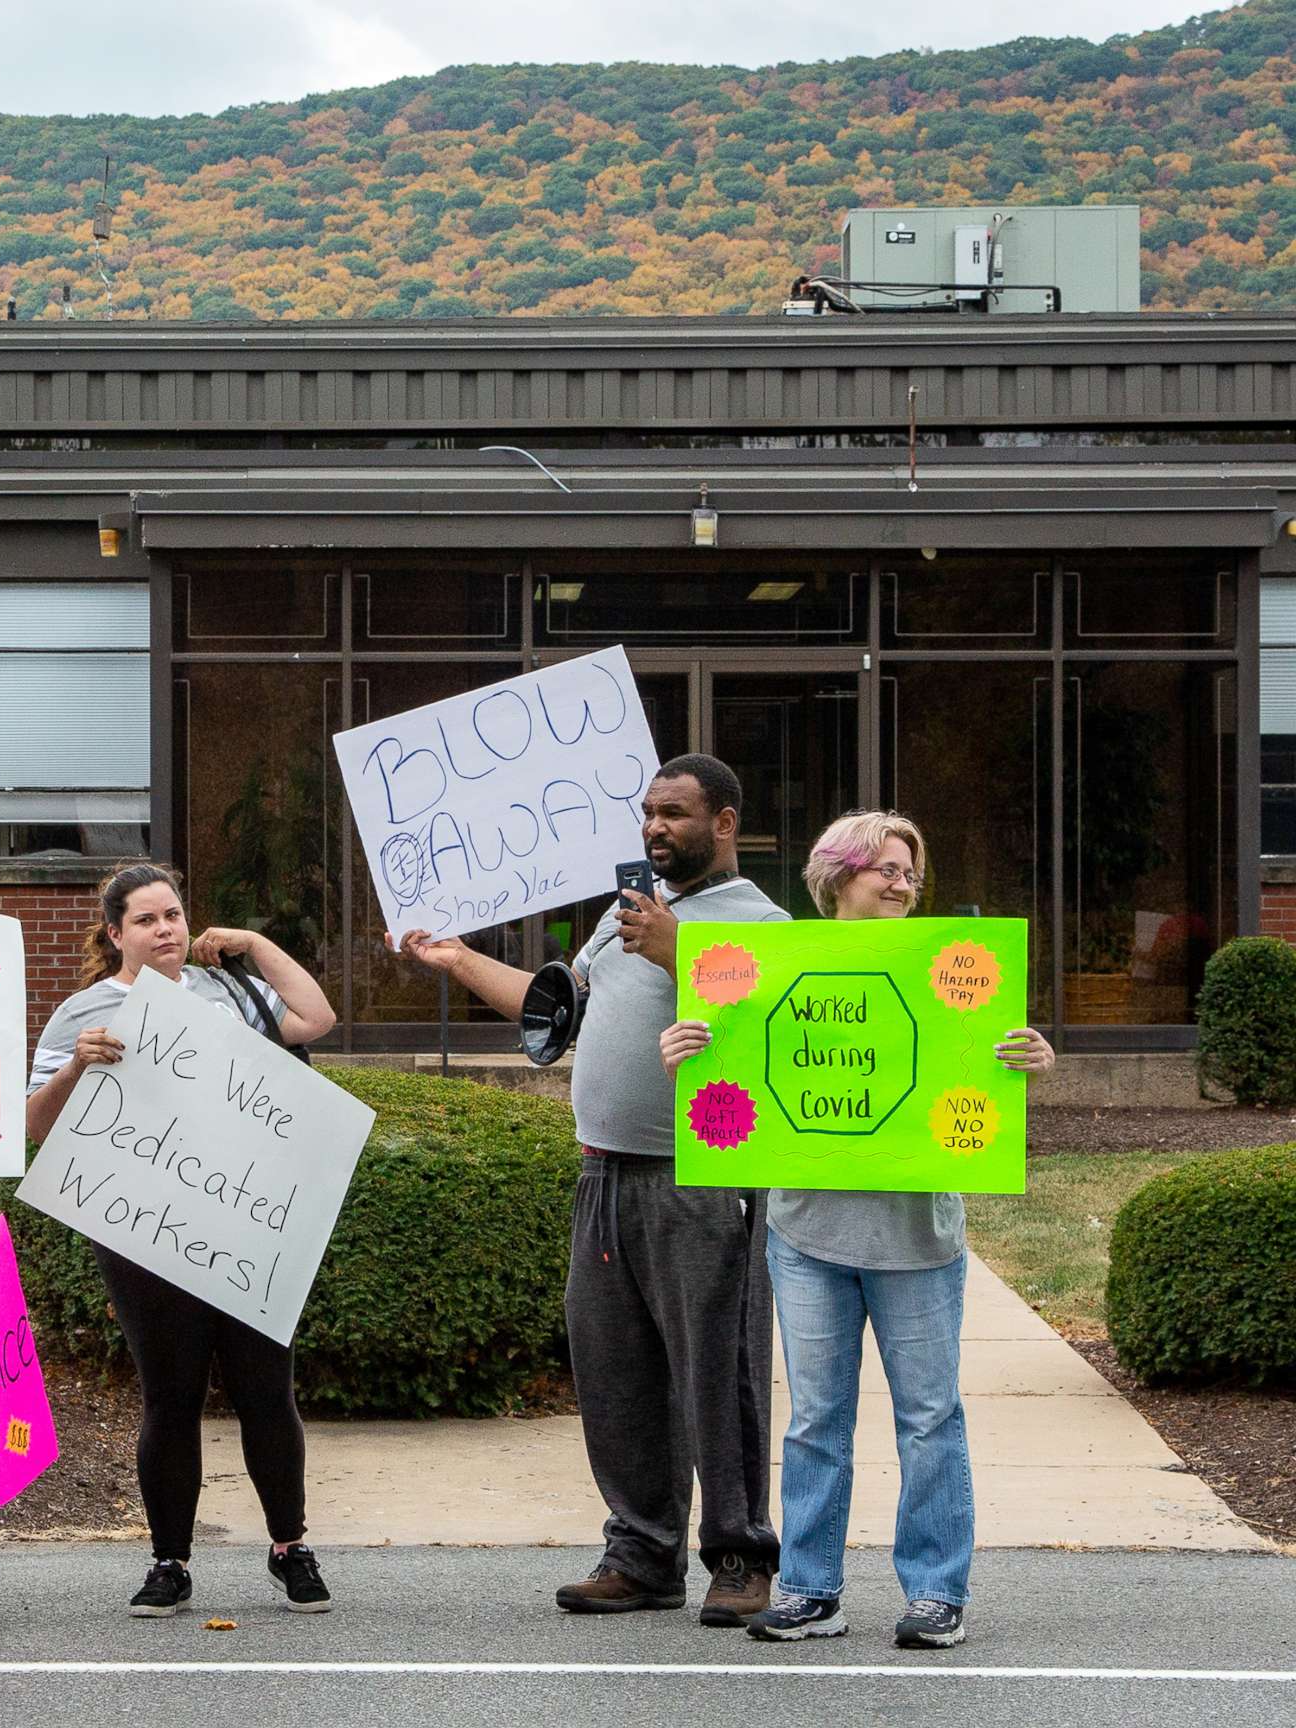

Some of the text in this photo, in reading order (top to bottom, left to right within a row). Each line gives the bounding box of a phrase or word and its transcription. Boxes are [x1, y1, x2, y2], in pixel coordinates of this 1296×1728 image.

[363, 663, 626, 824] BLOW
[429, 754, 644, 884] AWAY
[433, 867, 568, 932] Shop Vac
[697, 963, 754, 984] Essential
[952, 955, 975, 968] NO
[789, 991, 866, 1023] Worked
[946, 988, 974, 1005] PAY
[793, 1029, 876, 1076] during
[136, 1002, 293, 1138] We Were
[709, 1092, 735, 1105] NO
[801, 1088, 873, 1119] Covid
[945, 1098, 987, 1114] NOW
[701, 1125, 745, 1140] Apart
[954, 1118, 983, 1133] NO
[70, 1070, 297, 1232] Dedicated
[944, 1136, 983, 1149] Job
[59, 1156, 281, 1315] Workers!
